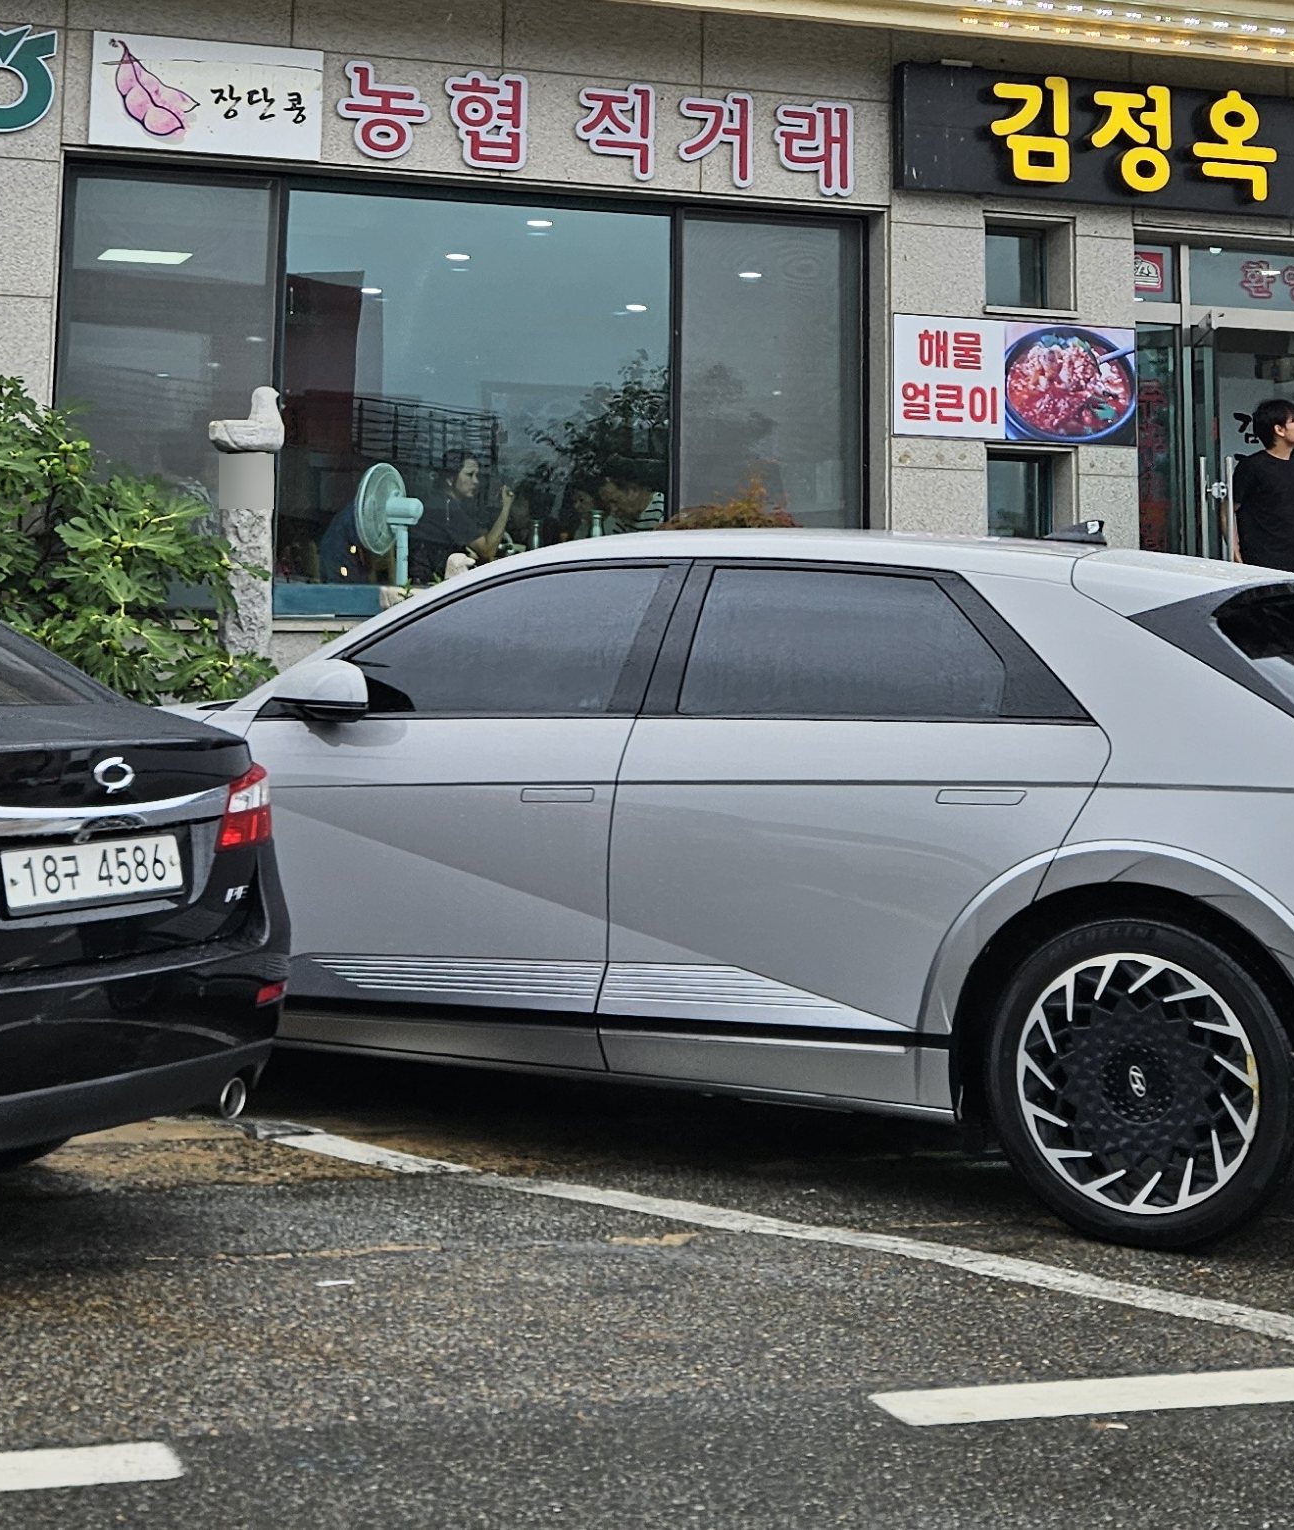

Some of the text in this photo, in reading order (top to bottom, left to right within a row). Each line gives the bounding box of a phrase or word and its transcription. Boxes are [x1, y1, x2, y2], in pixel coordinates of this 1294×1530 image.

[210, 84, 307, 124] 장단콩
[336, 60, 855, 197] 농협 직거래
[990, 76, 1278, 202] 김정옥
[918, 329, 982, 370] 해물
[902, 382, 998, 424] 얼큰이
[22, 843, 167, 897] 18구 4586
